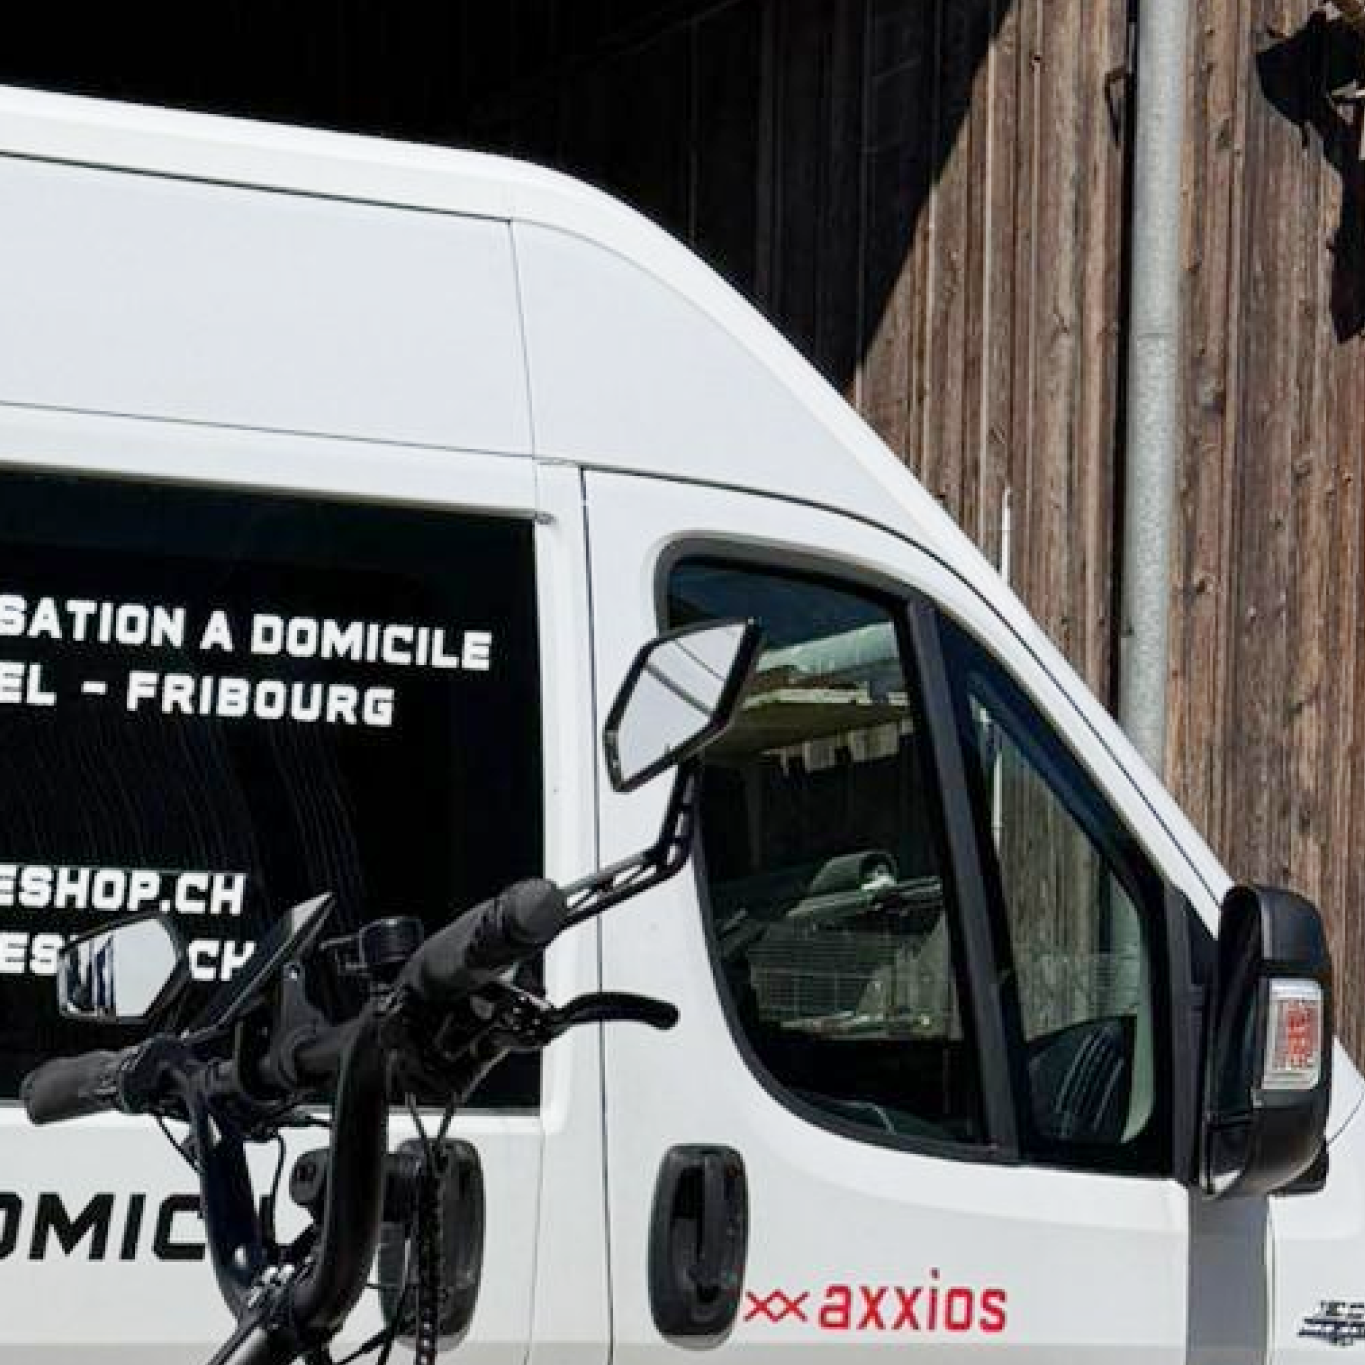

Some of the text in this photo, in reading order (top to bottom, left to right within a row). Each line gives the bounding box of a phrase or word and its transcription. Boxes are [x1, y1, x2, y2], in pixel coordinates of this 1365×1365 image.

[199, 610, 233, 652] A
[250, 613, 492, 672] DOMICILE
[126, 670, 395, 726] FRIBOURG
[817, 1266, 1007, 1333] axxios
